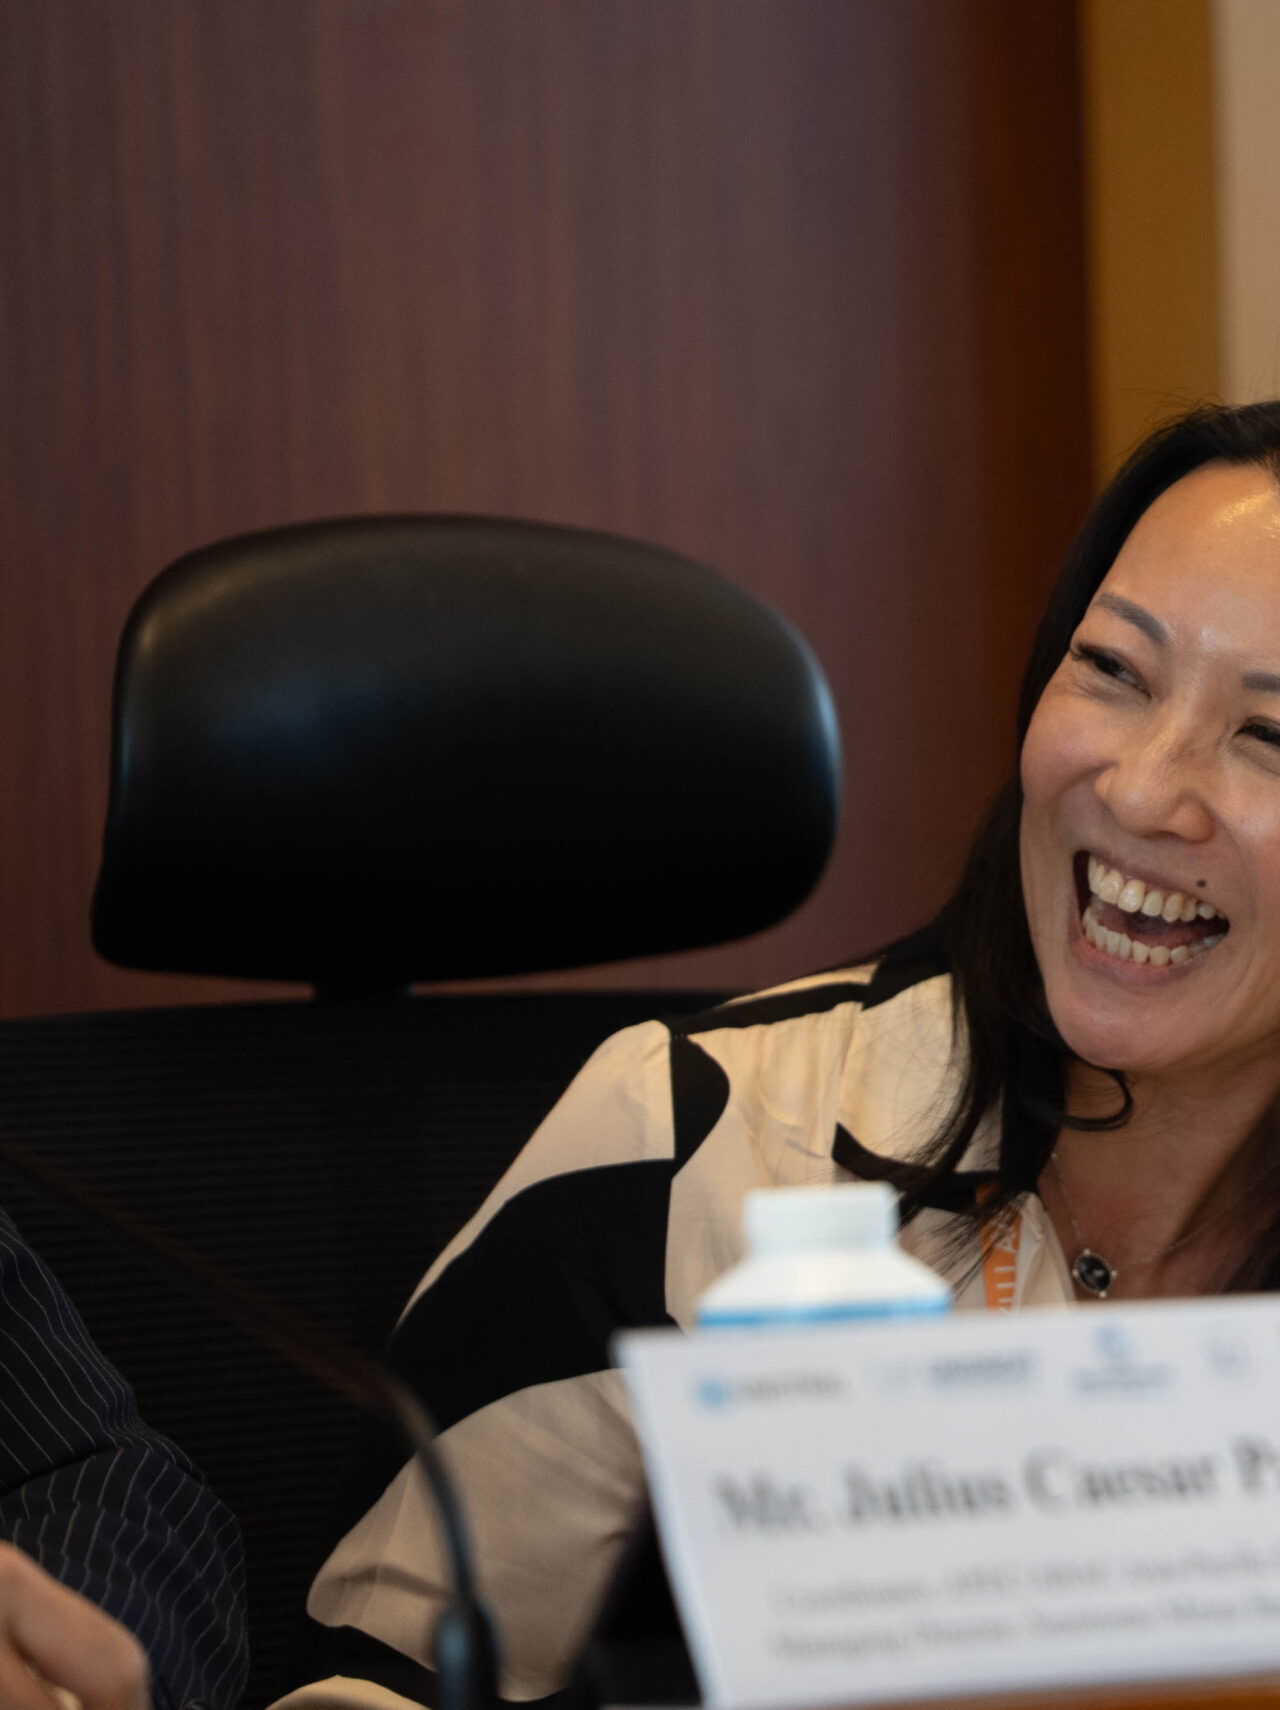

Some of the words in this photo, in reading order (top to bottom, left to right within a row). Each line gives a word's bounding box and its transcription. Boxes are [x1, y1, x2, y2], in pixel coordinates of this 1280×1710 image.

[711, 1470, 826, 1538] Mr.
[841, 1459, 1016, 1530] Julius
[1023, 1445, 1222, 1514] Caesar
